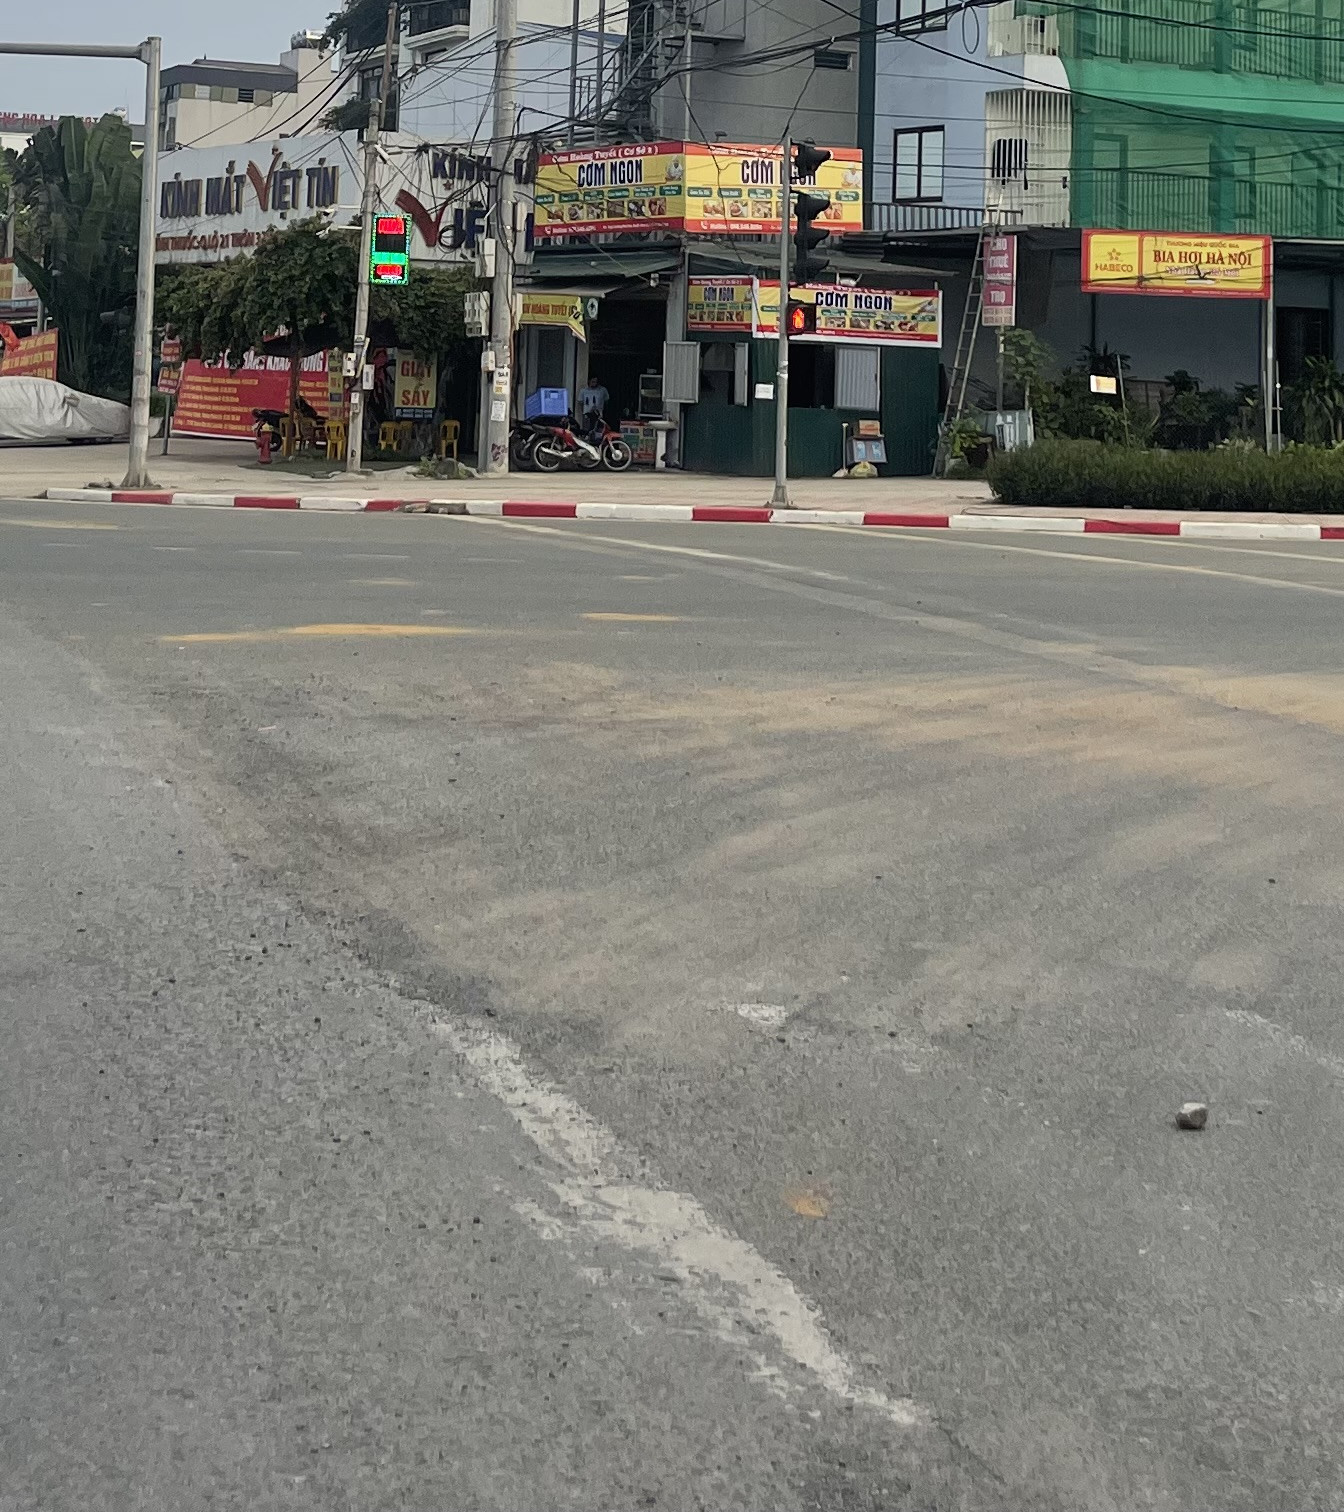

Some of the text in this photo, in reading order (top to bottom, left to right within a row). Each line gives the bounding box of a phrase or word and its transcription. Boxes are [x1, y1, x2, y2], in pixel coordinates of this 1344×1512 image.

[578, 159, 643, 188] CƠM NGON
[741, 158, 773, 185] CƠM
[160, 152, 339, 220] KÍNH MẮT VIỆT TÍN
[1095, 263, 1133, 273] HABECO
[1153, 248, 1252, 269] BIA HƠI HÀ NỘI
[815, 291, 848, 307] CƠM
[855, 295, 893, 311] NGON
